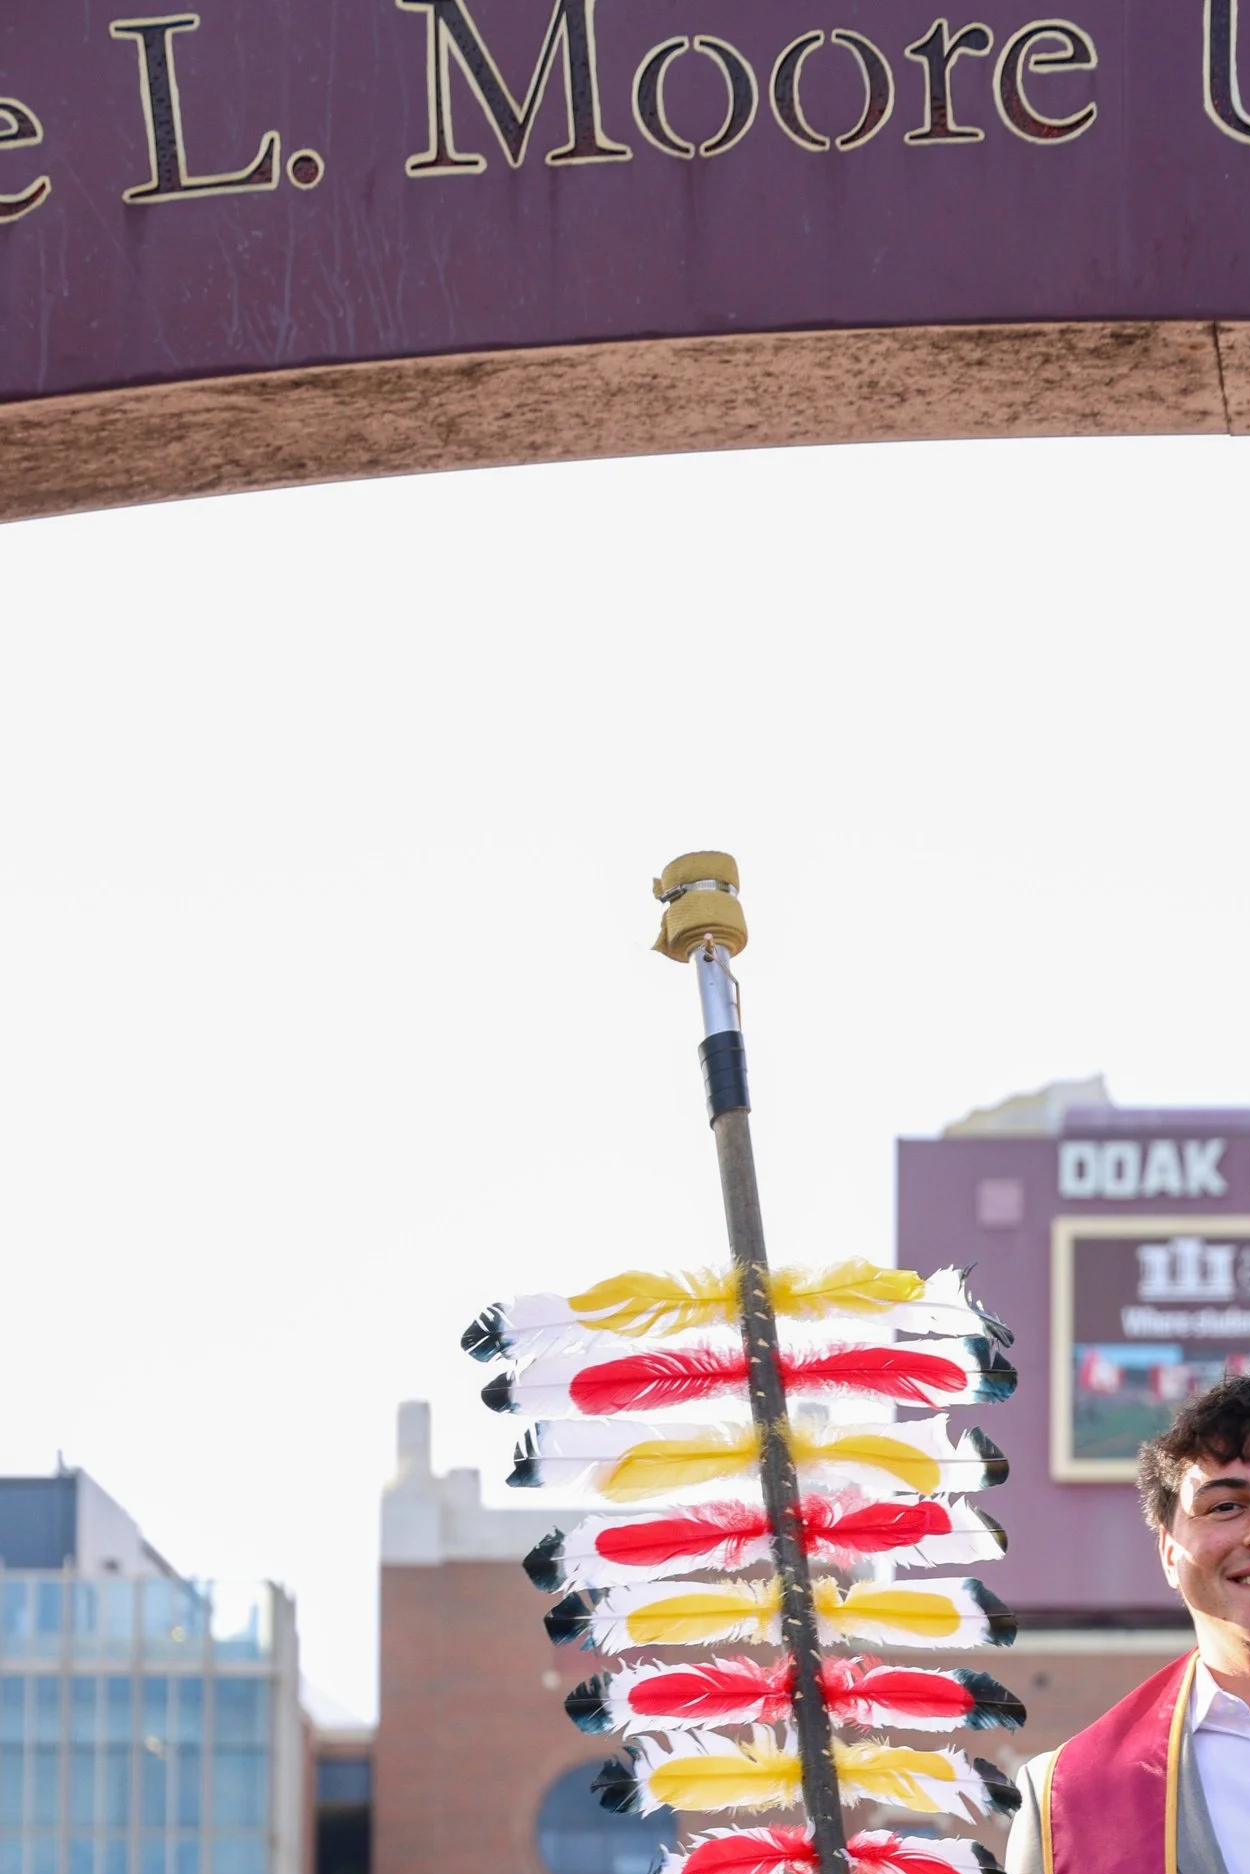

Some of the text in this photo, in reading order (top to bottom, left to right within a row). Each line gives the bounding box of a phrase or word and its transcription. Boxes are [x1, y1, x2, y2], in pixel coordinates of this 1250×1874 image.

[110, 14, 324, 203] L.
[396, 0, 1097, 179] Moore
[1058, 1138, 1229, 1198] DOAK
